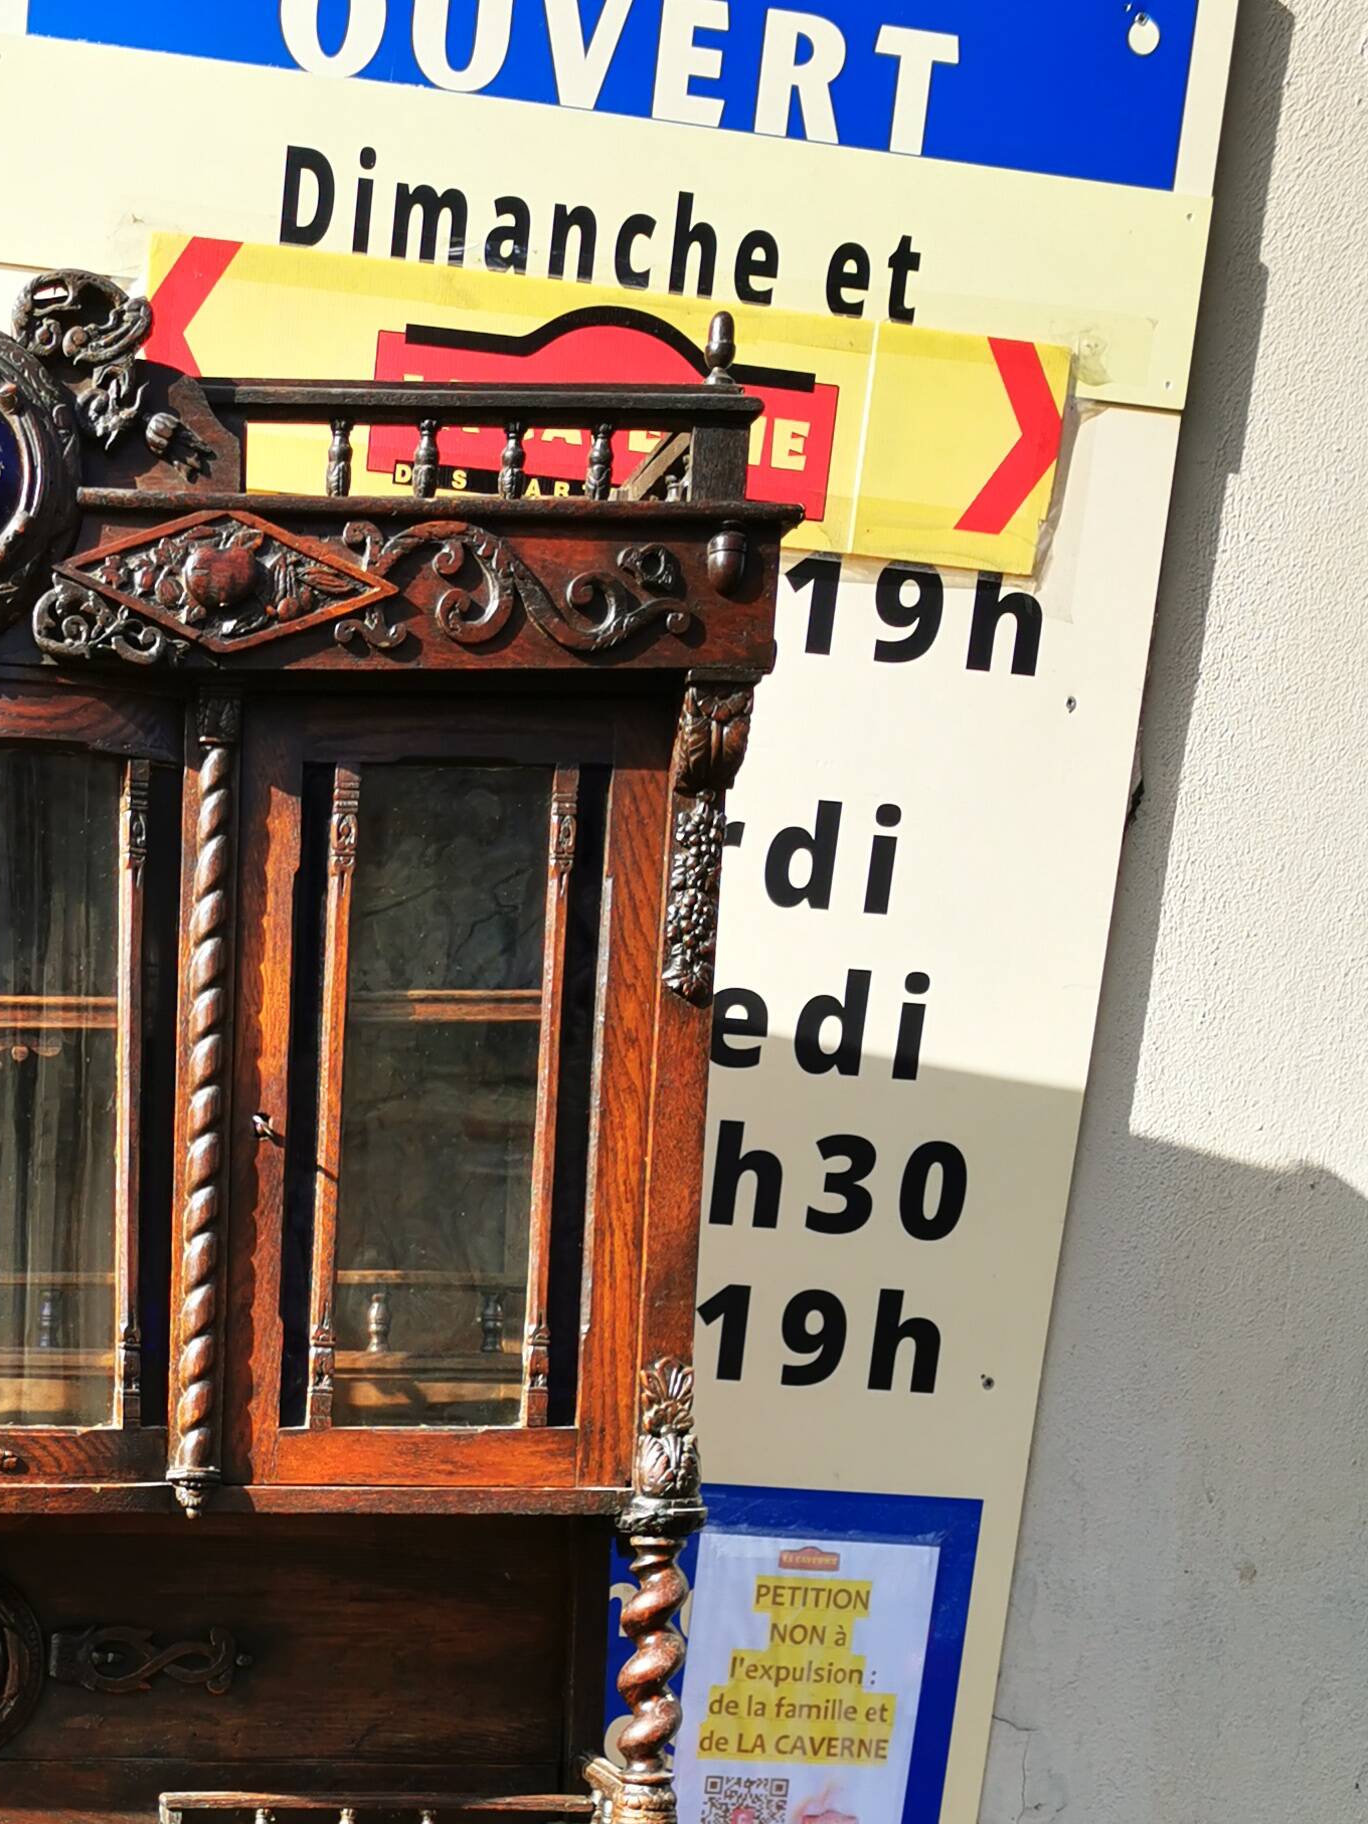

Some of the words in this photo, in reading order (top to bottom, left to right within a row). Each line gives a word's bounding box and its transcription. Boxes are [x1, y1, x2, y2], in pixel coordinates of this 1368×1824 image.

[279, 0, 960, 156] OUVERT
[279, 144, 780, 307] Dimanche
[825, 234, 922, 323] et
[785, 553, 1043, 676] 19h
[709, 1120, 967, 1241] h30
[696, 1284, 941, 1393] 19h
[754, 1584, 871, 1611] PETITION
[769, 1623, 826, 1645] NON
[834, 1625, 847, 1646] à
[730, 1657, 863, 1686] l'expulsion
[709, 1694, 739, 1715] de
[747, 1695, 766, 1717] la
[775, 1697, 857, 1721] famille
[866, 1703, 888, 1722] et
[699, 1730, 728, 1752] de
[737, 1733, 765, 1755] LA
[775, 1735, 888, 1759] CAVERNE
